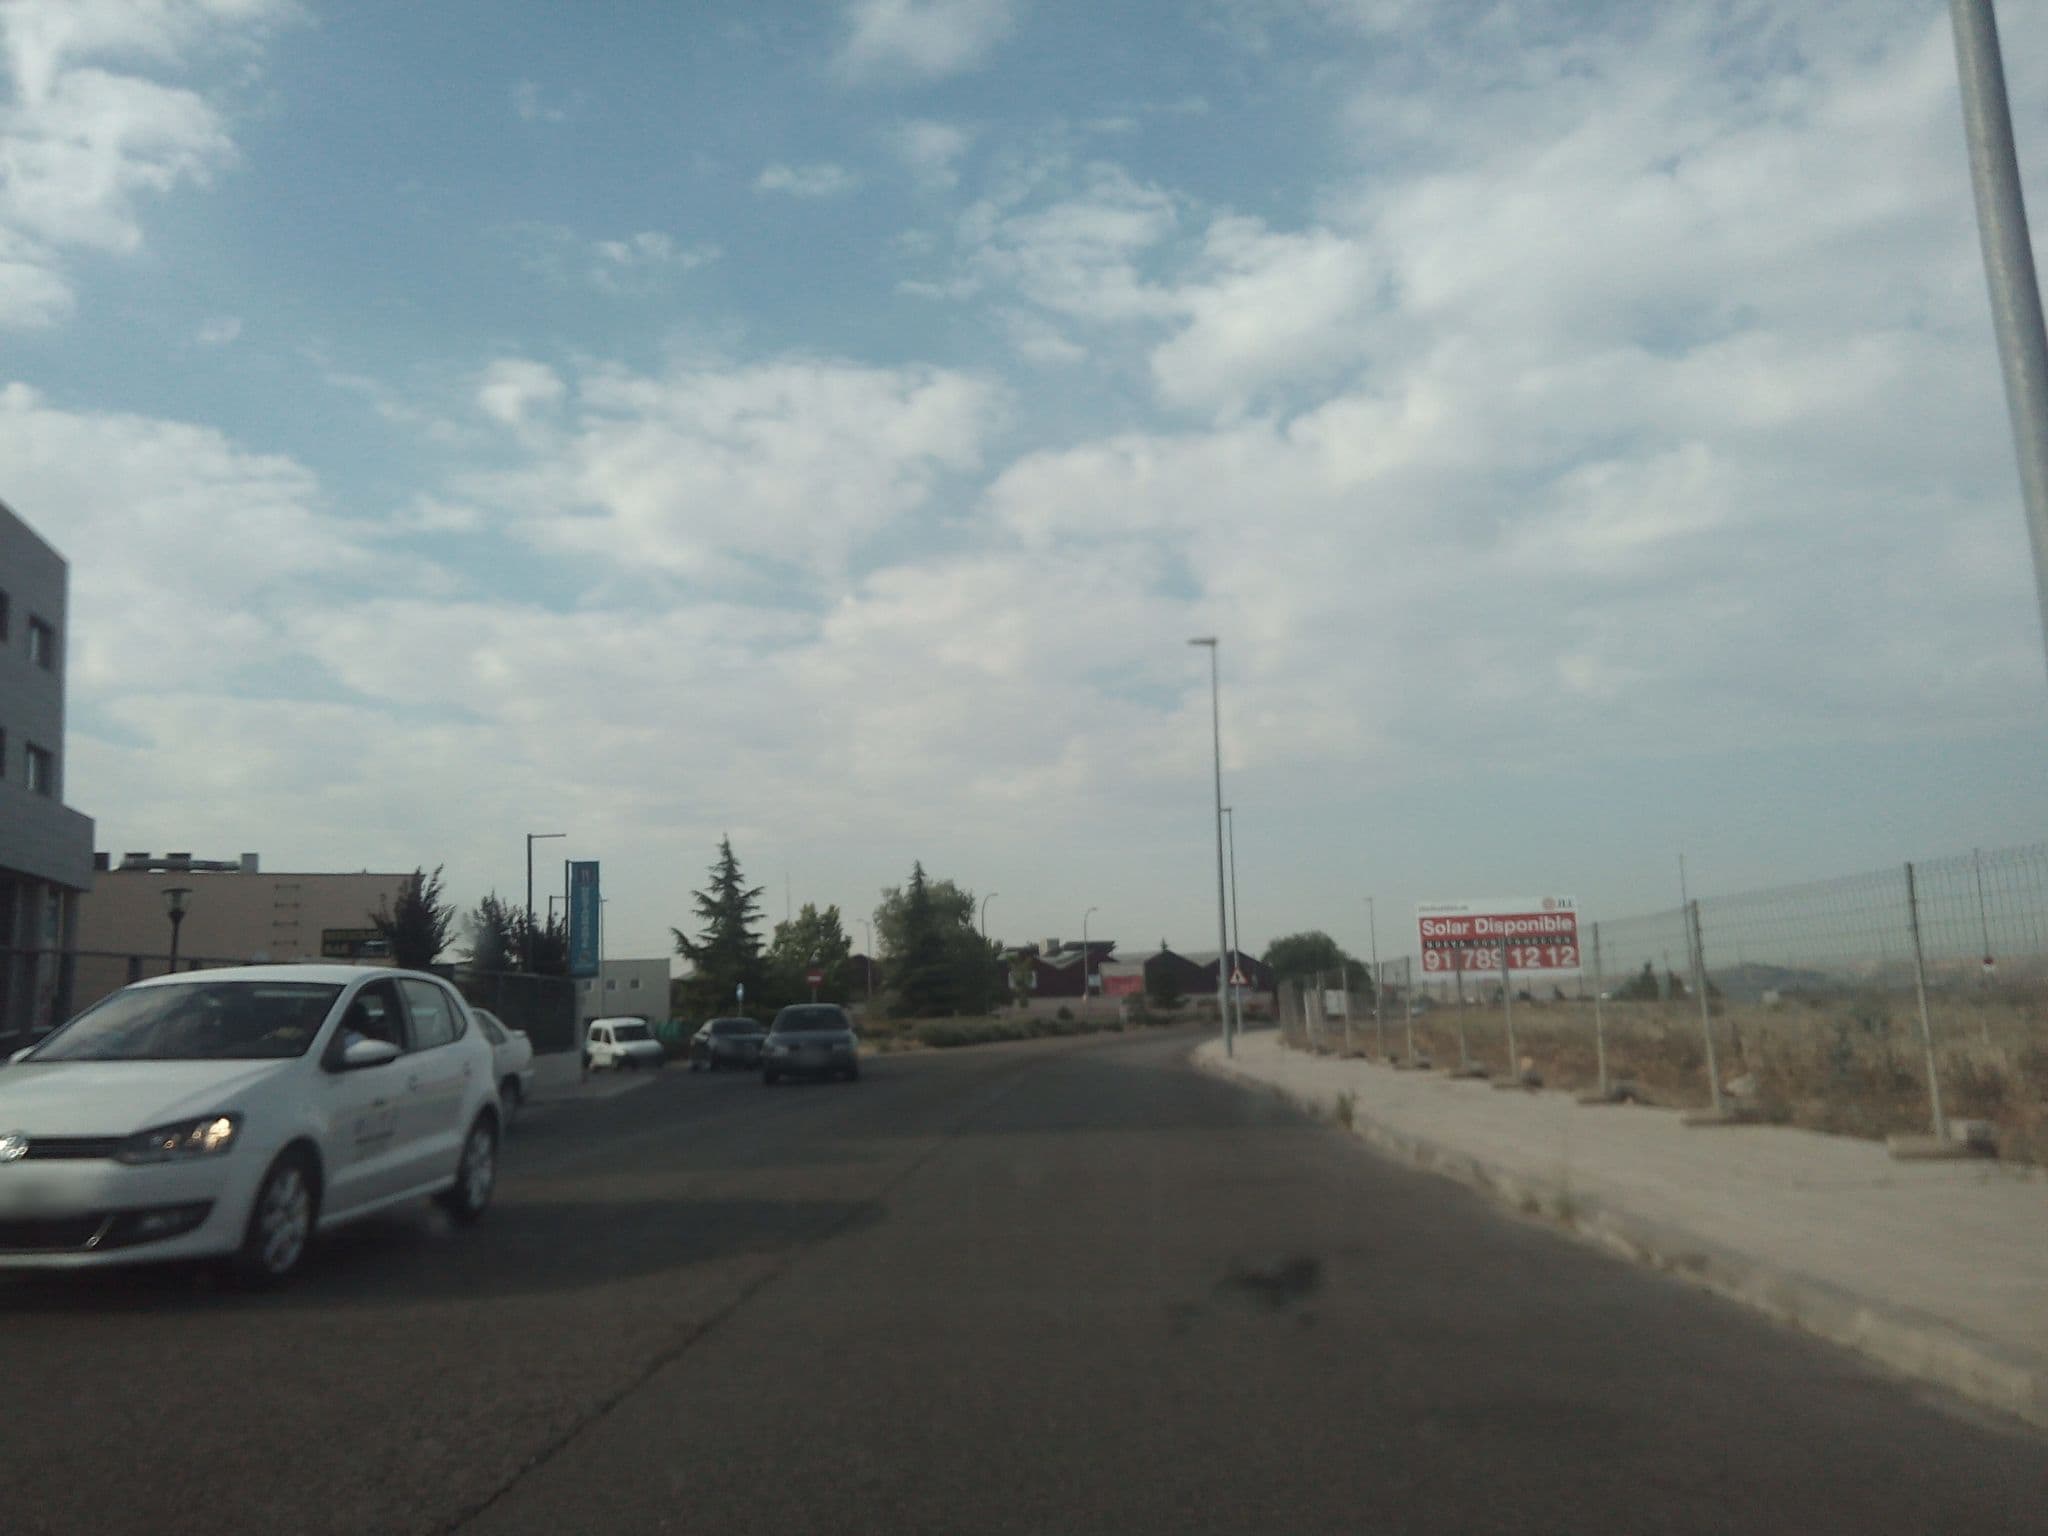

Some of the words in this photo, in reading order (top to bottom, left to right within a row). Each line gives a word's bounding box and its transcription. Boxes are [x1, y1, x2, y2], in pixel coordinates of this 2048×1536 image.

[1422, 919, 1470, 937] Solar
[1474, 915, 1573, 936] Disponible
[1424, 950, 1451, 971] 91
[1461, 949, 1501, 969] 789
[1511, 947, 1541, 968] 12
[1546, 946, 1576, 968] 12
